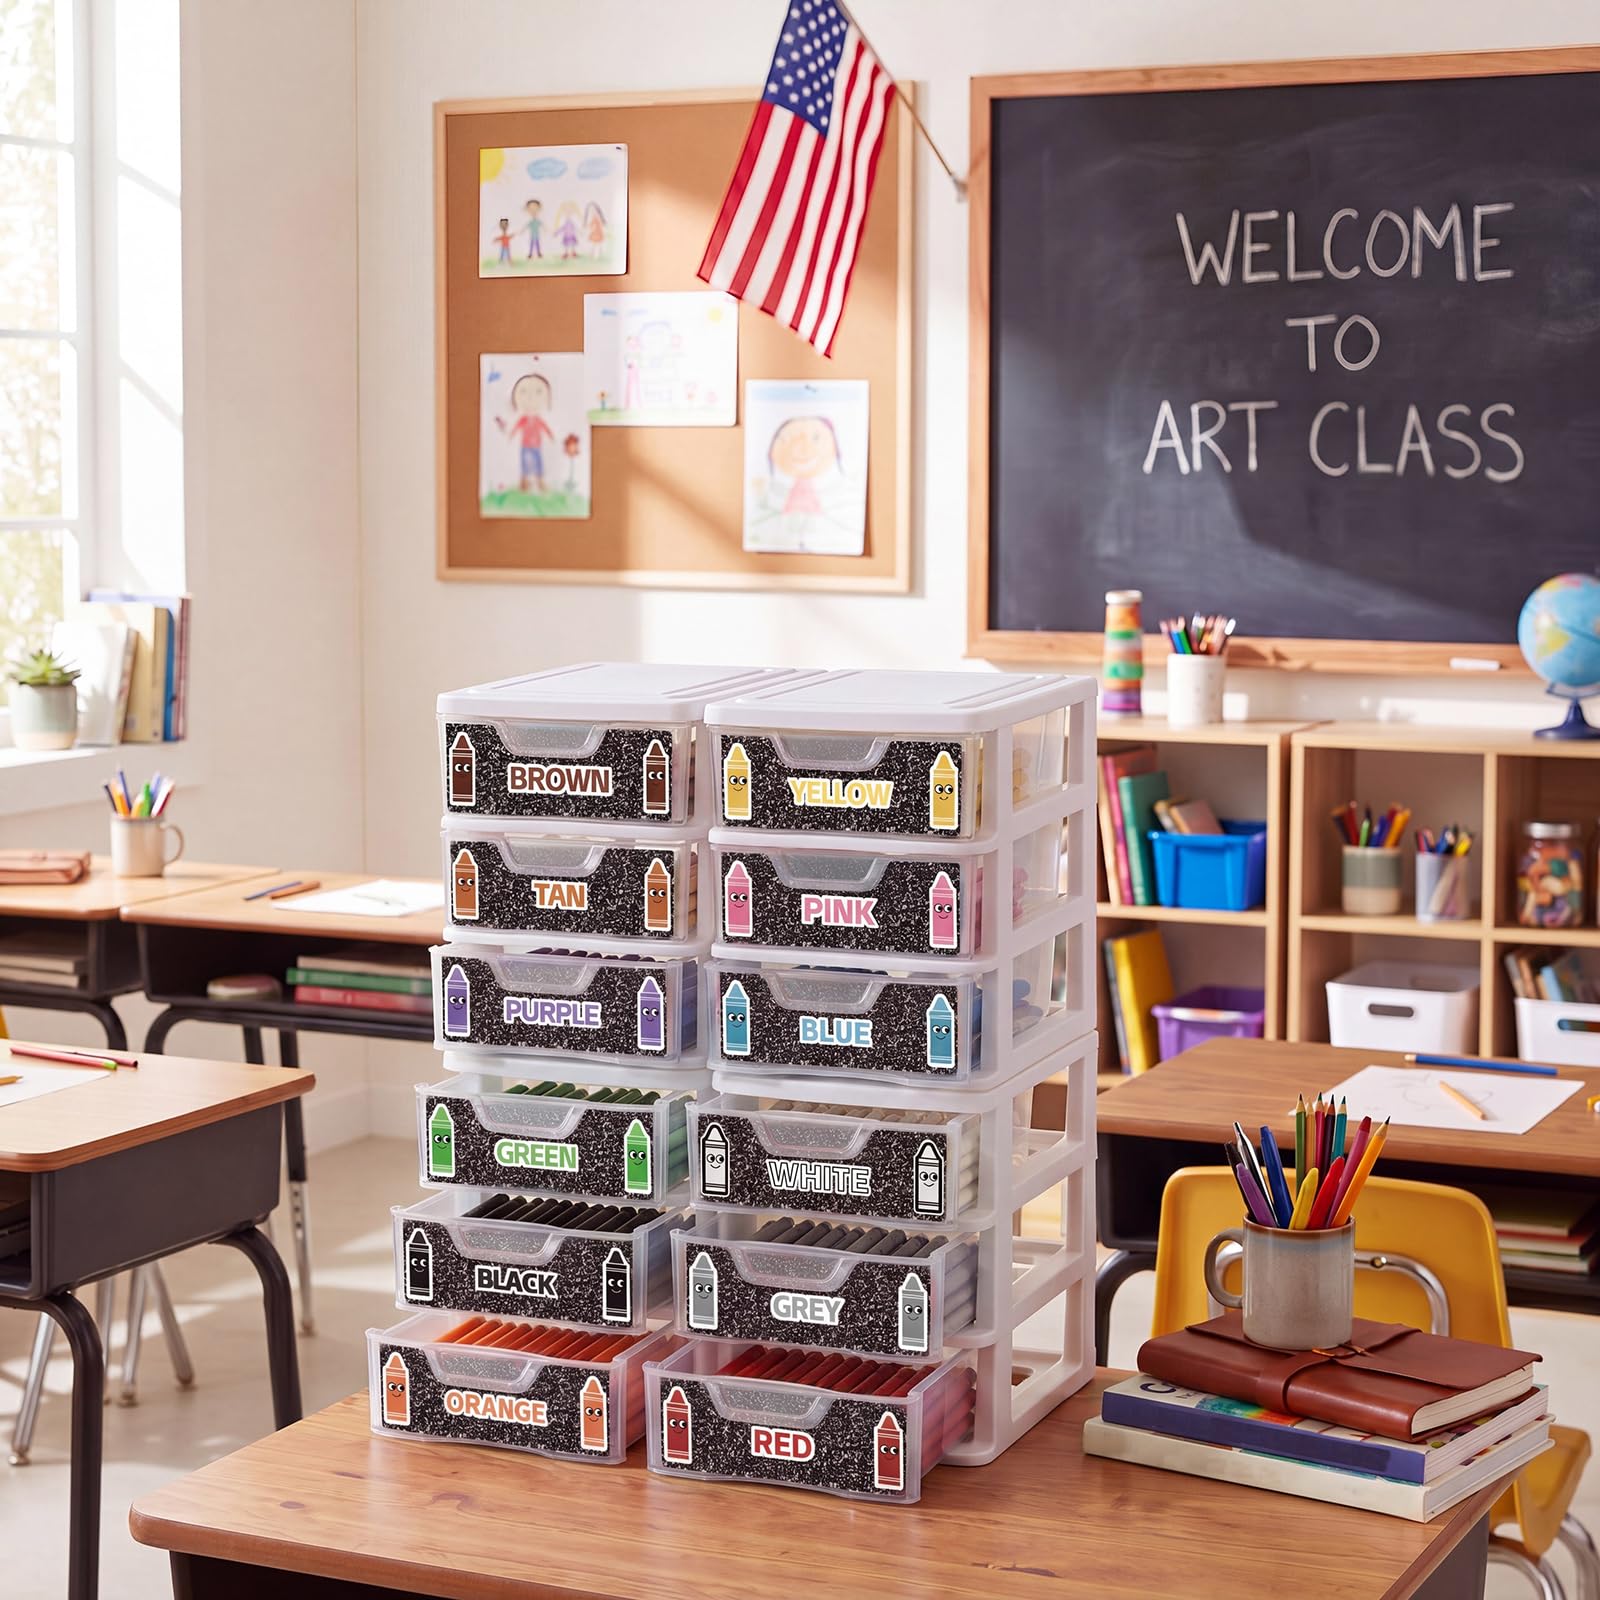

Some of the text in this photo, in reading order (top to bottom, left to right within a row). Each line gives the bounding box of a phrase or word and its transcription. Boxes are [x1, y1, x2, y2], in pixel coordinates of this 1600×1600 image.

[1176, 203, 1514, 286] WELCOME
[1285, 314, 1380, 372] TO
[1142, 400, 1524, 482] ART CLASS
[509, 765, 611, 794] BROWN
[788, 779, 893, 808] YELLOW
[532, 881, 586, 909] TAN
[802, 896, 877, 927] PINK
[505, 998, 600, 1027] PURPLE
[800, 1017, 872, 1046] BLUE
[495, 1140, 578, 1170] GREEN
[767, 1161, 870, 1195] WHITE
[476, 1266, 557, 1298] BLACK
[771, 1293, 843, 1324] GREY
[445, 1390, 547, 1425] ORANGE
[753, 1428, 813, 1459] RED
